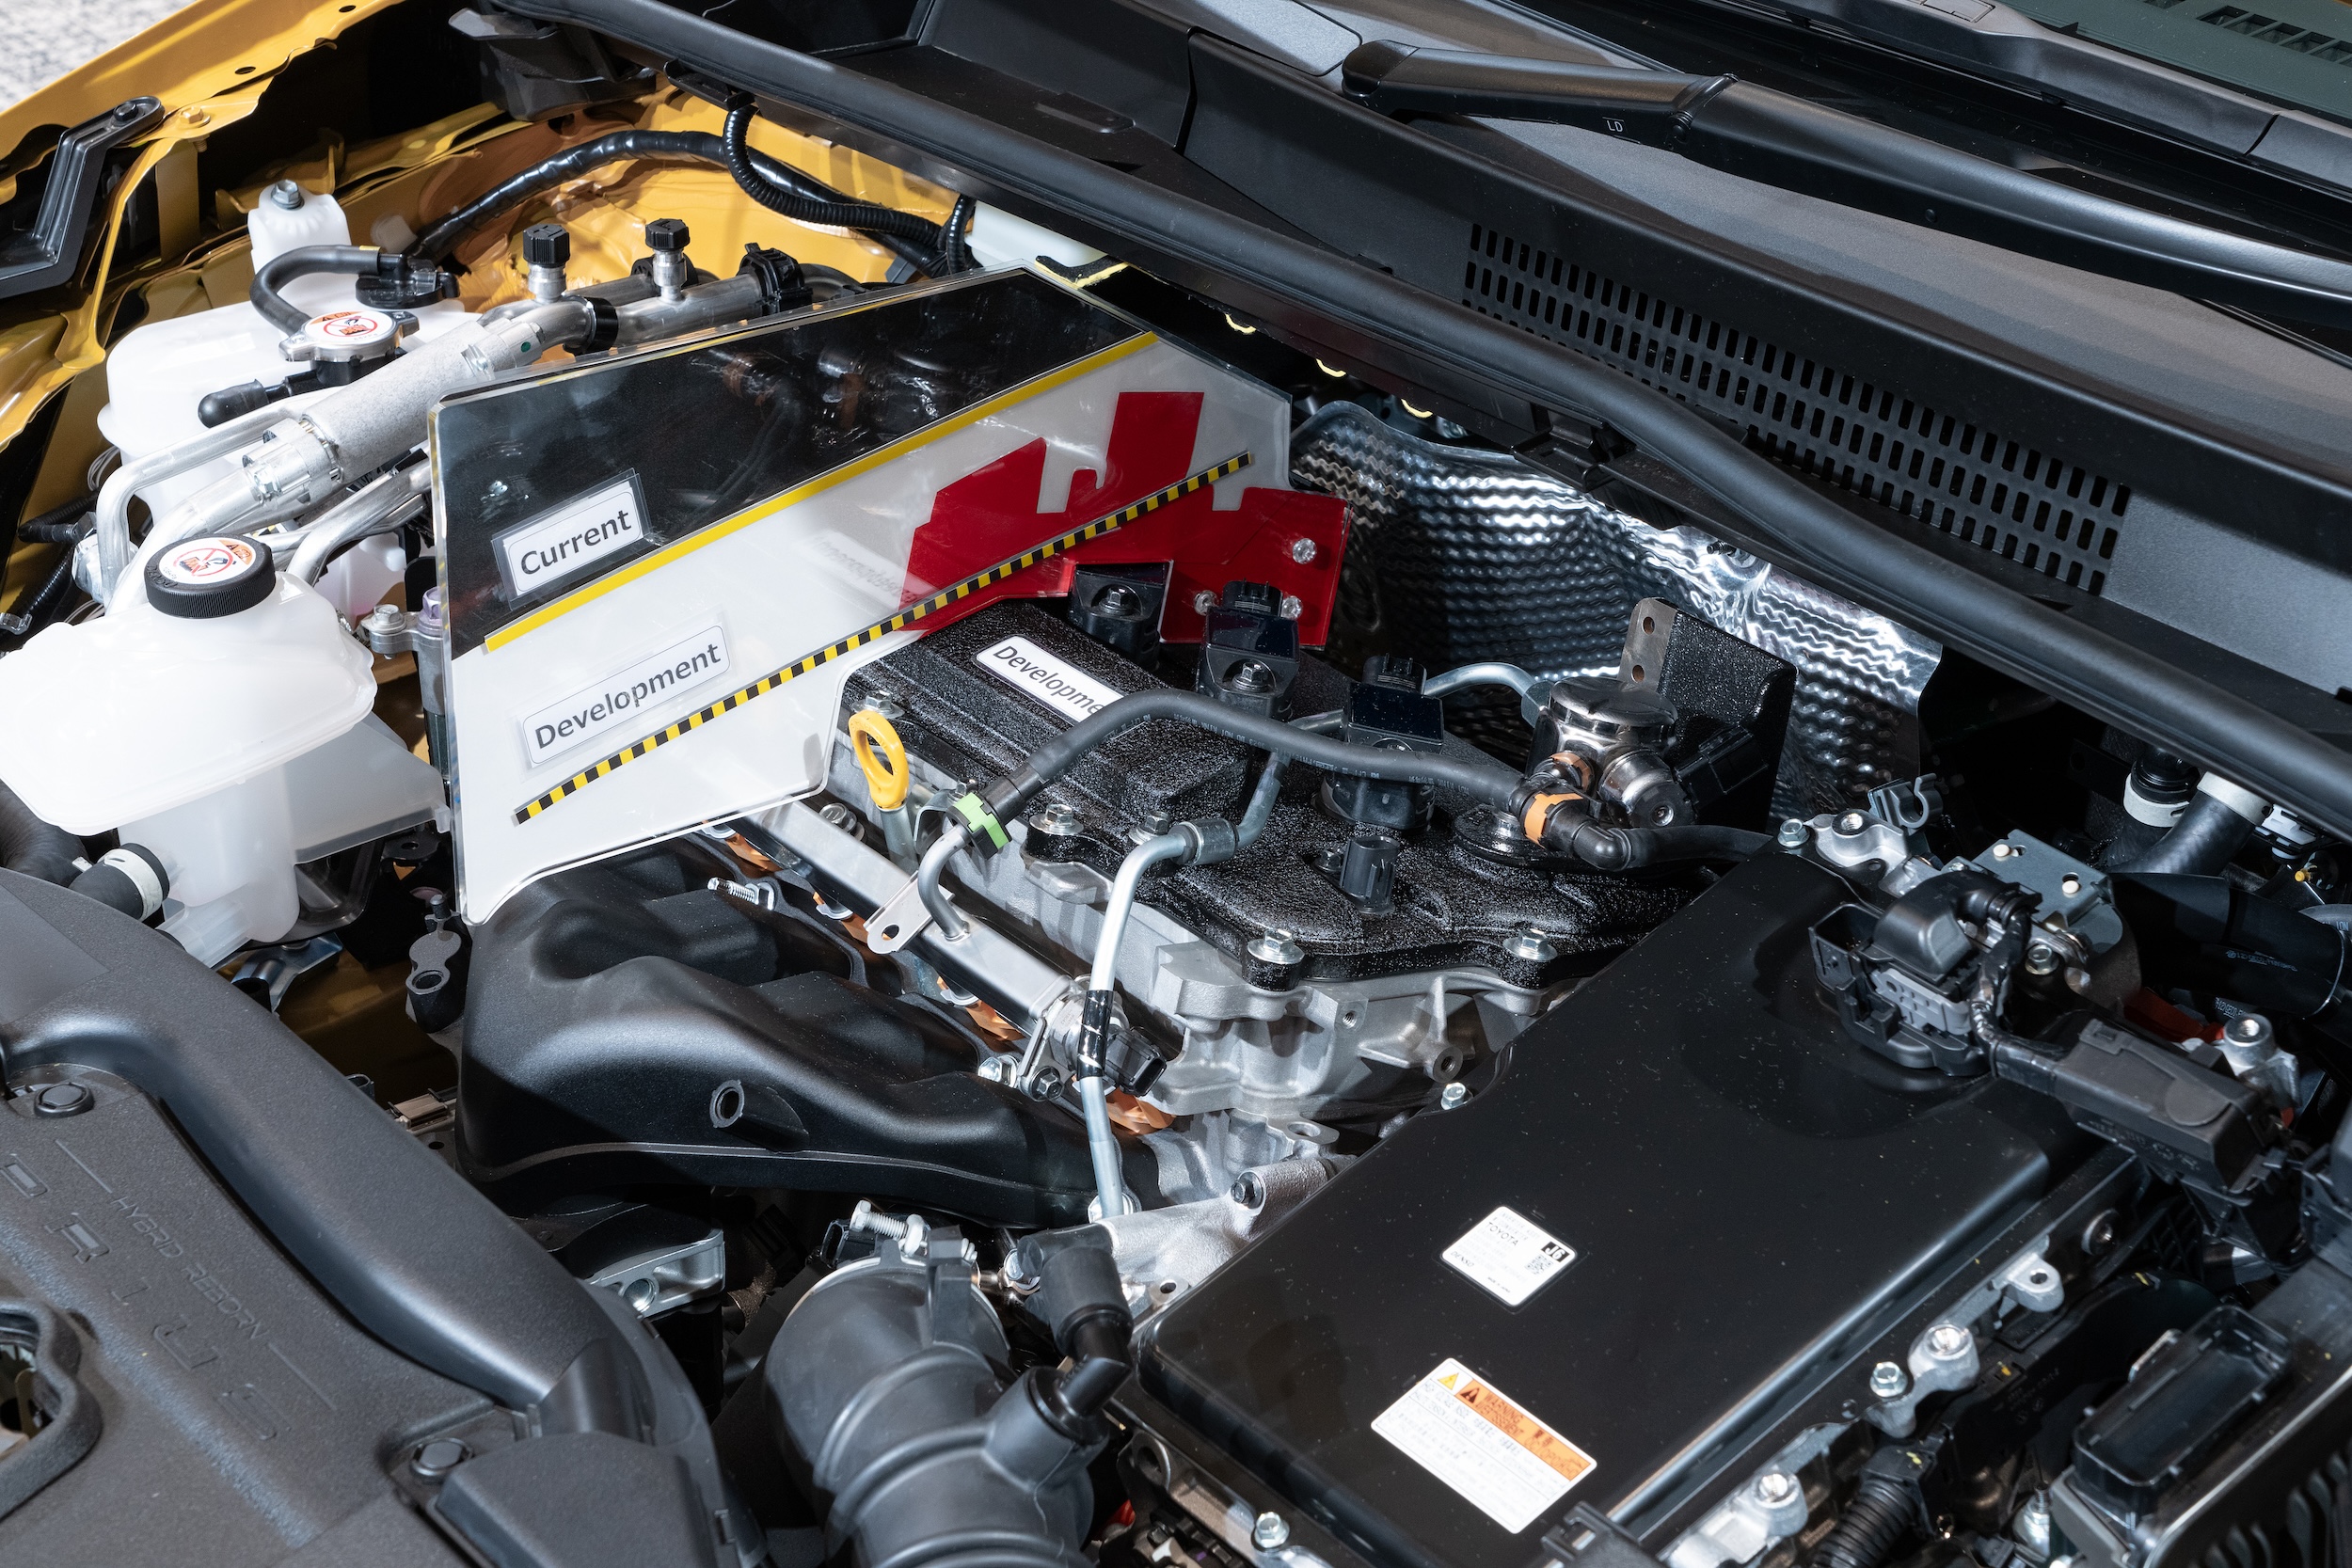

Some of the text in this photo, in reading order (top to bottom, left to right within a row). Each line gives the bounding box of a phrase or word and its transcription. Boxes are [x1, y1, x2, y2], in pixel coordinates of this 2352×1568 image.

[1606, 119, 1624, 132] LD
[520, 509, 632, 576] Current
[533, 643, 722, 750] Development
[993, 645, 1105, 715] Developme
[110, 1196, 183, 1259] HYBRID
[1486, 1221, 1519, 1246] TOYOTA
[1544, 1245, 1565, 1260] J6
[0, 1153, 292, 1441] PRIUS
[182, 1261, 271, 1340] REBORN
[1483, 1391, 1524, 1424] WARNING
